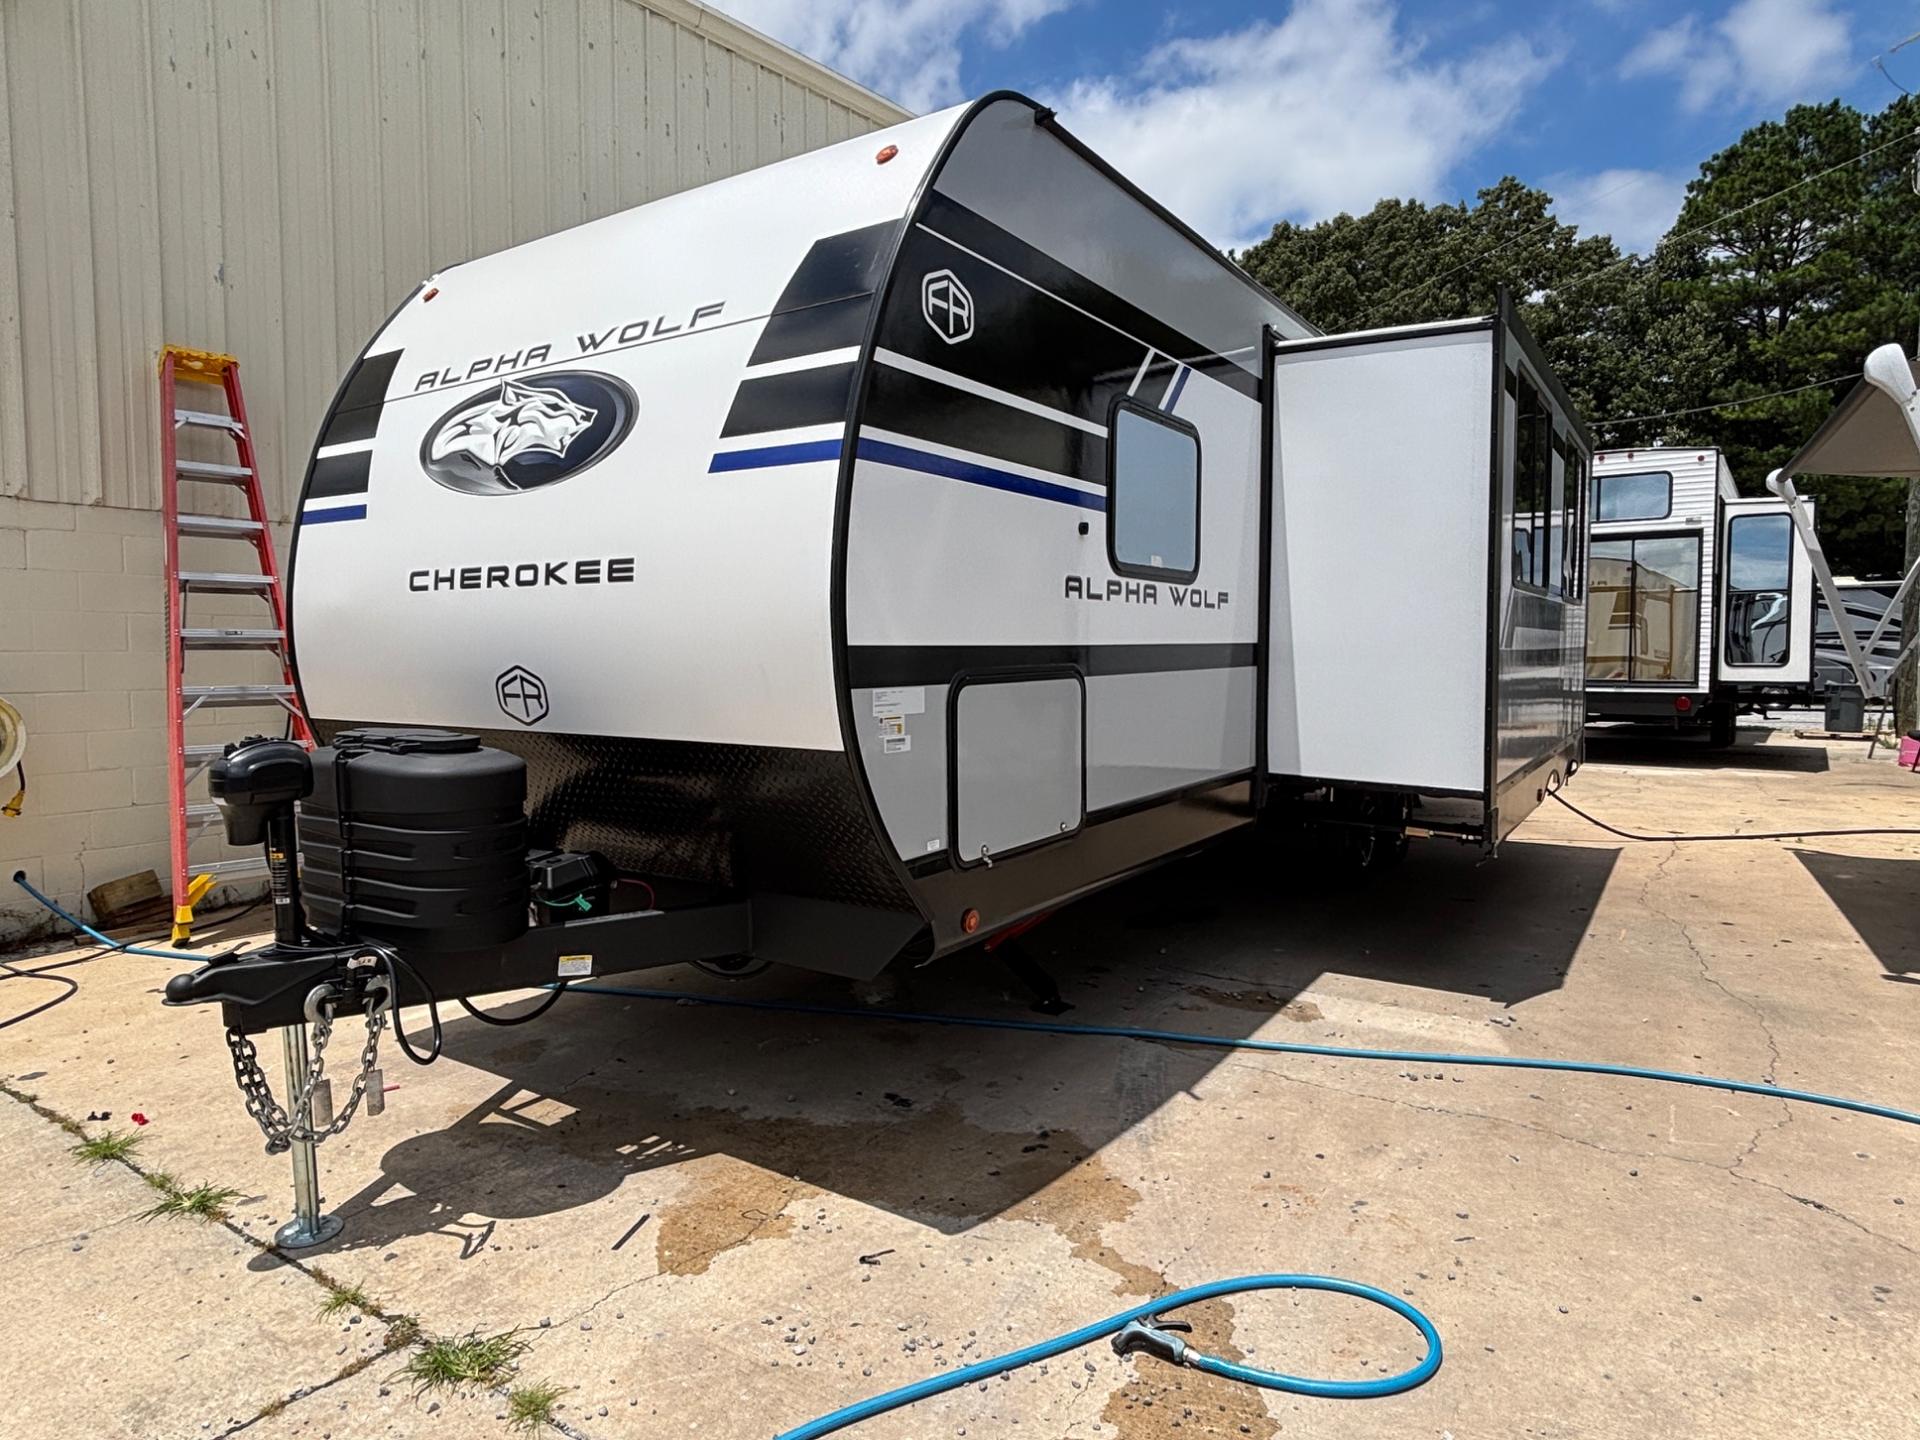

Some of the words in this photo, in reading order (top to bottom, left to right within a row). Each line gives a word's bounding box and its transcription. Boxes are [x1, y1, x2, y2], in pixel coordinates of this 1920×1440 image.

[414, 343, 552, 391] ALPHA
[577, 301, 725, 352] WOLF
[409, 557, 635, 592] CHEROKEE
[1065, 575, 1157, 605] ALPHA
[1169, 586, 1229, 609] WOLF
